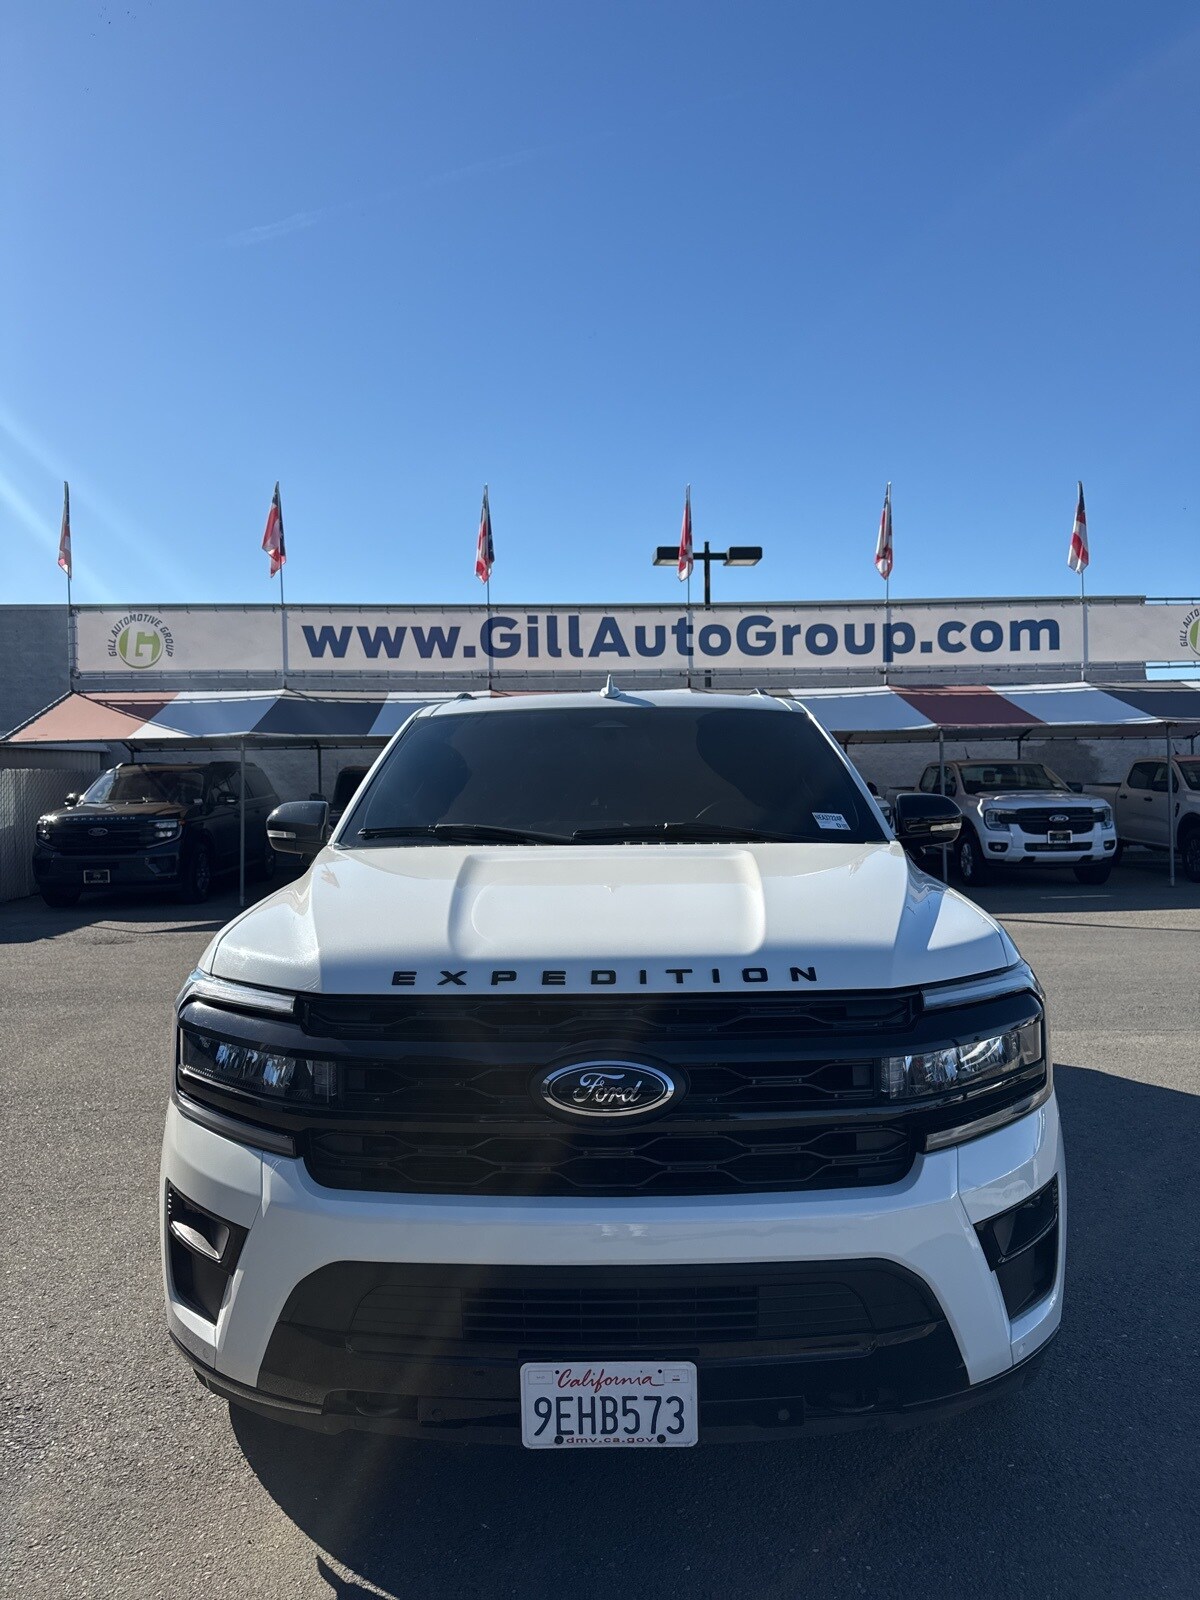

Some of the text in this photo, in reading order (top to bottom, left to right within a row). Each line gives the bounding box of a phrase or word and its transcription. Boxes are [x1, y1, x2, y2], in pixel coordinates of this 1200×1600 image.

[108, 613, 175, 658] GILL AUTOMOTIVE GROUP
[301, 614, 1061, 663] www.GillAutoGroup.com
[1179, 630, 1189, 647] GILL
[391, 966, 818, 986] EXPEDITION
[572, 1072, 643, 1103] Ford
[557, 1368, 664, 1393] California
[533, 1395, 685, 1436] 9EHB573
[566, 1436, 654, 1444] dmv.ca.gov
